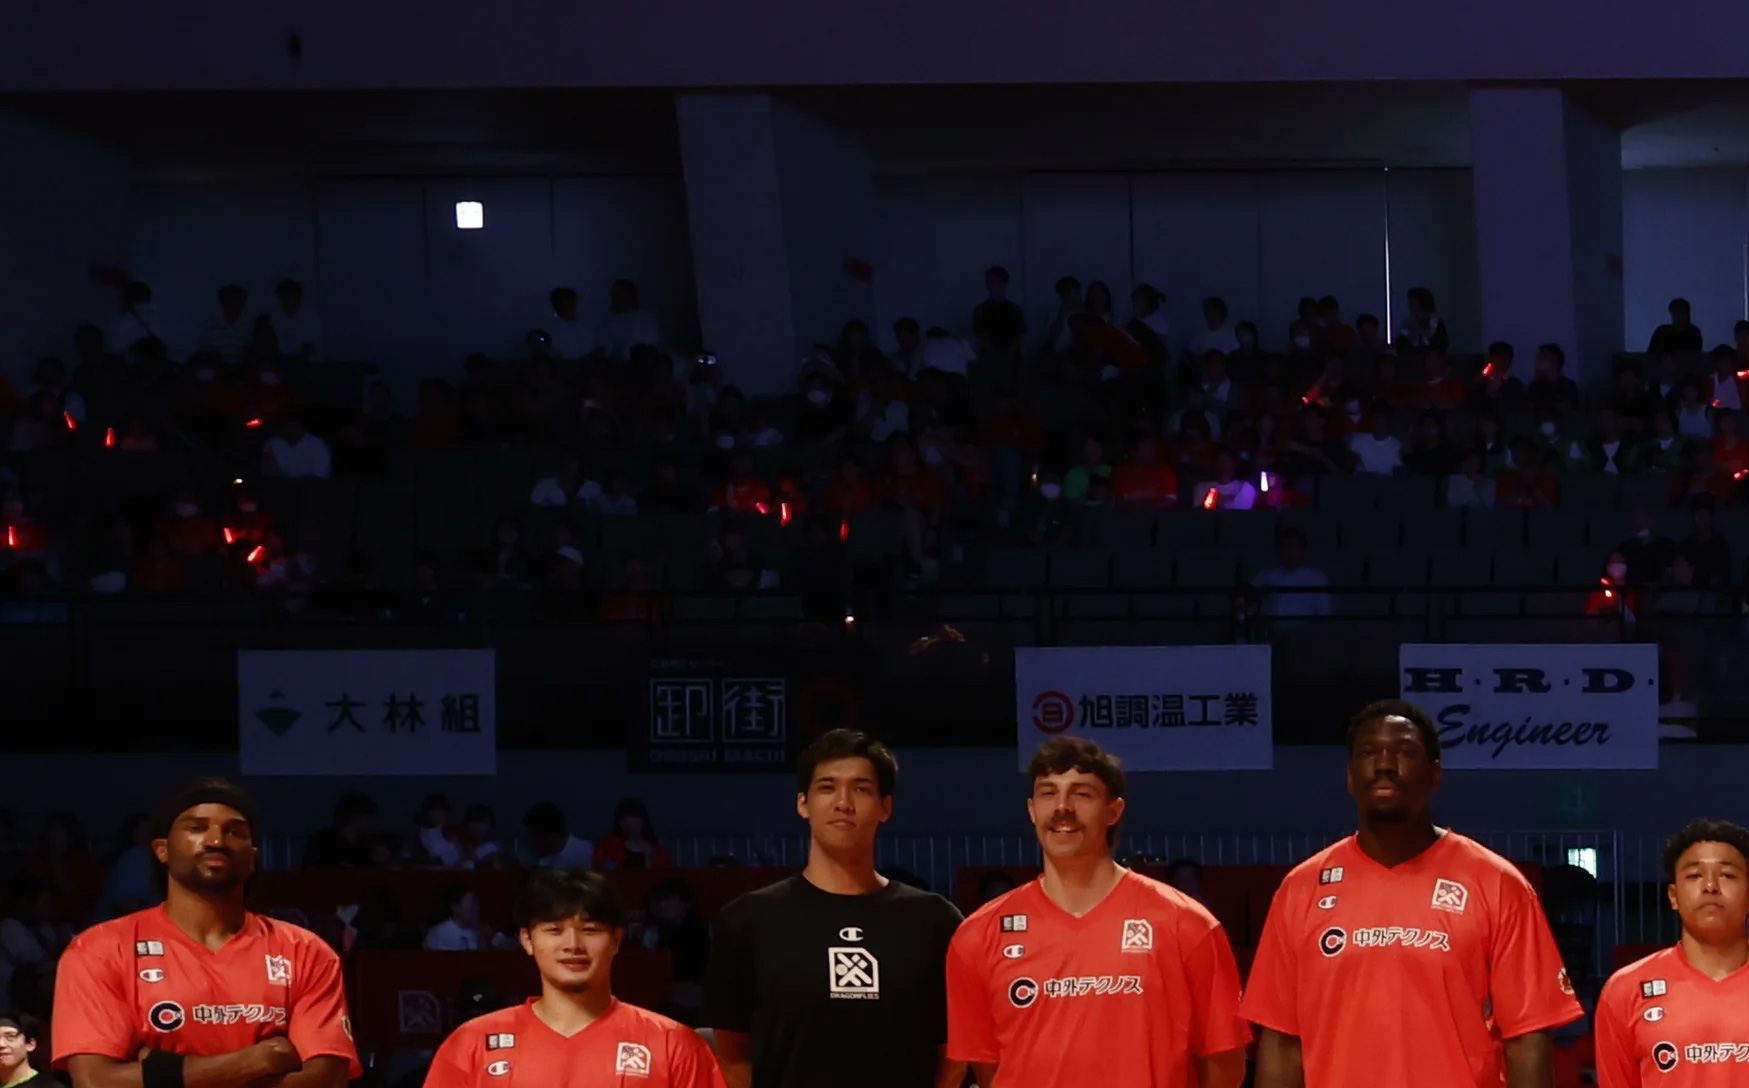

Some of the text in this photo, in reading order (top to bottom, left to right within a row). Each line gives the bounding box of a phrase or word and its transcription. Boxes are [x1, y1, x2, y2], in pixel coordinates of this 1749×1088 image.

[325, 692, 481, 734] 大林組
[1079, 692, 1259, 729] 旭調温工業
[1436, 704, 1612, 759] Engineer
[1353, 926, 1451, 952] 中外テクノス
[1044, 975, 1144, 999] 中外テクノス
